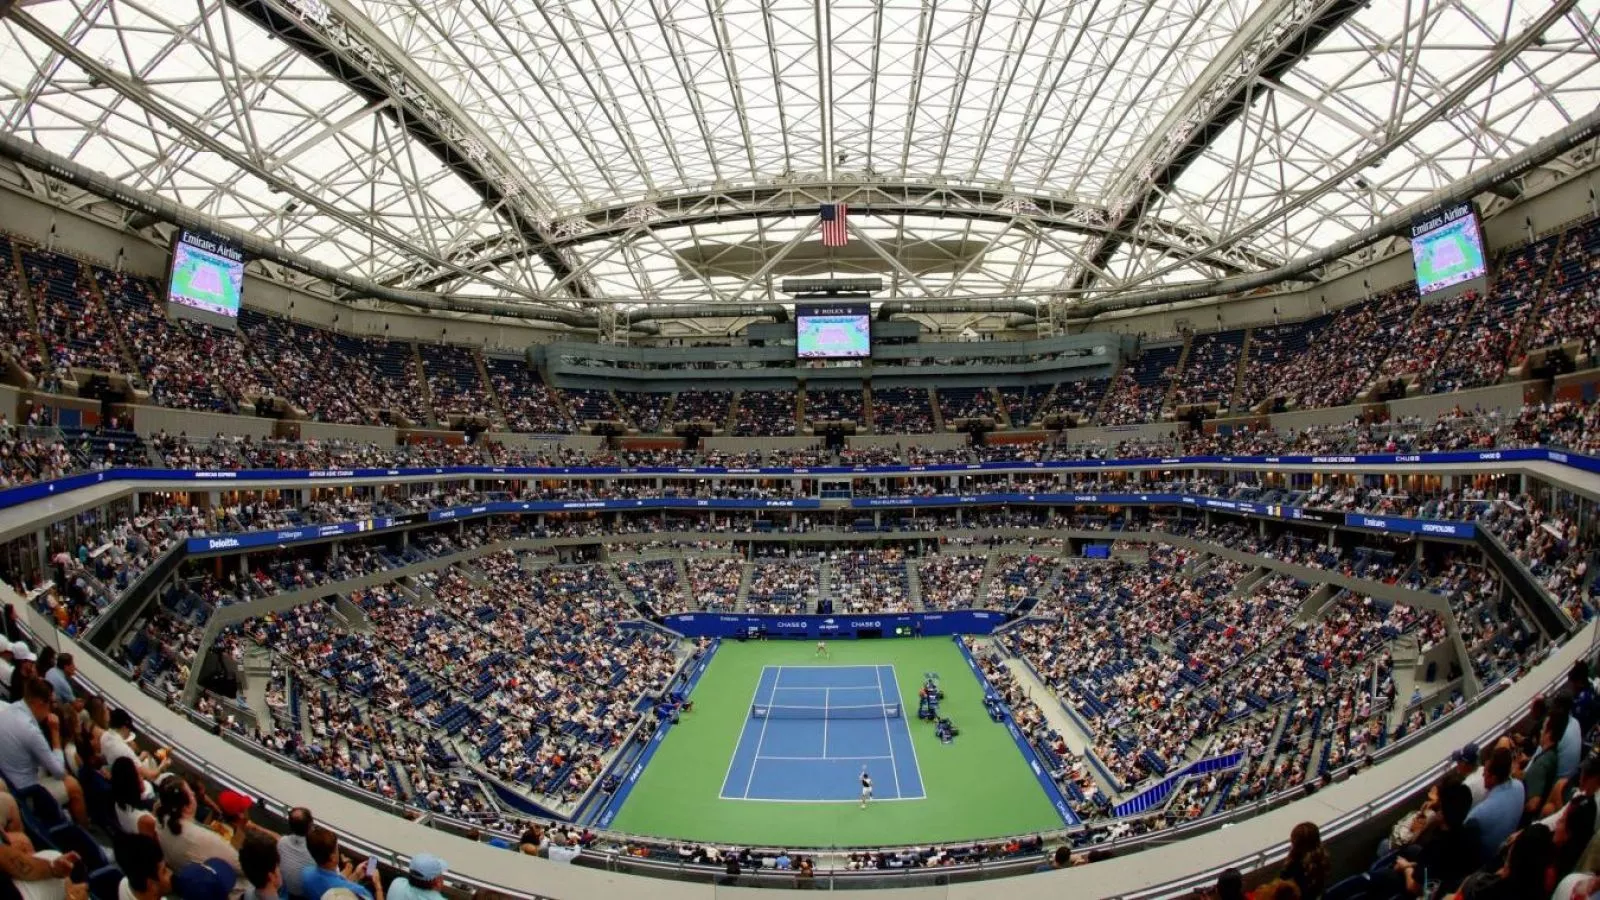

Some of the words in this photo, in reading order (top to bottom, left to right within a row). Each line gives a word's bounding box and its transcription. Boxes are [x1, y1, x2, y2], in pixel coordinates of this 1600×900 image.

[1412, 217, 1443, 237] Emirates
[182, 231, 216, 252] Emirates
[209, 539, 240, 549] Deloitte.
